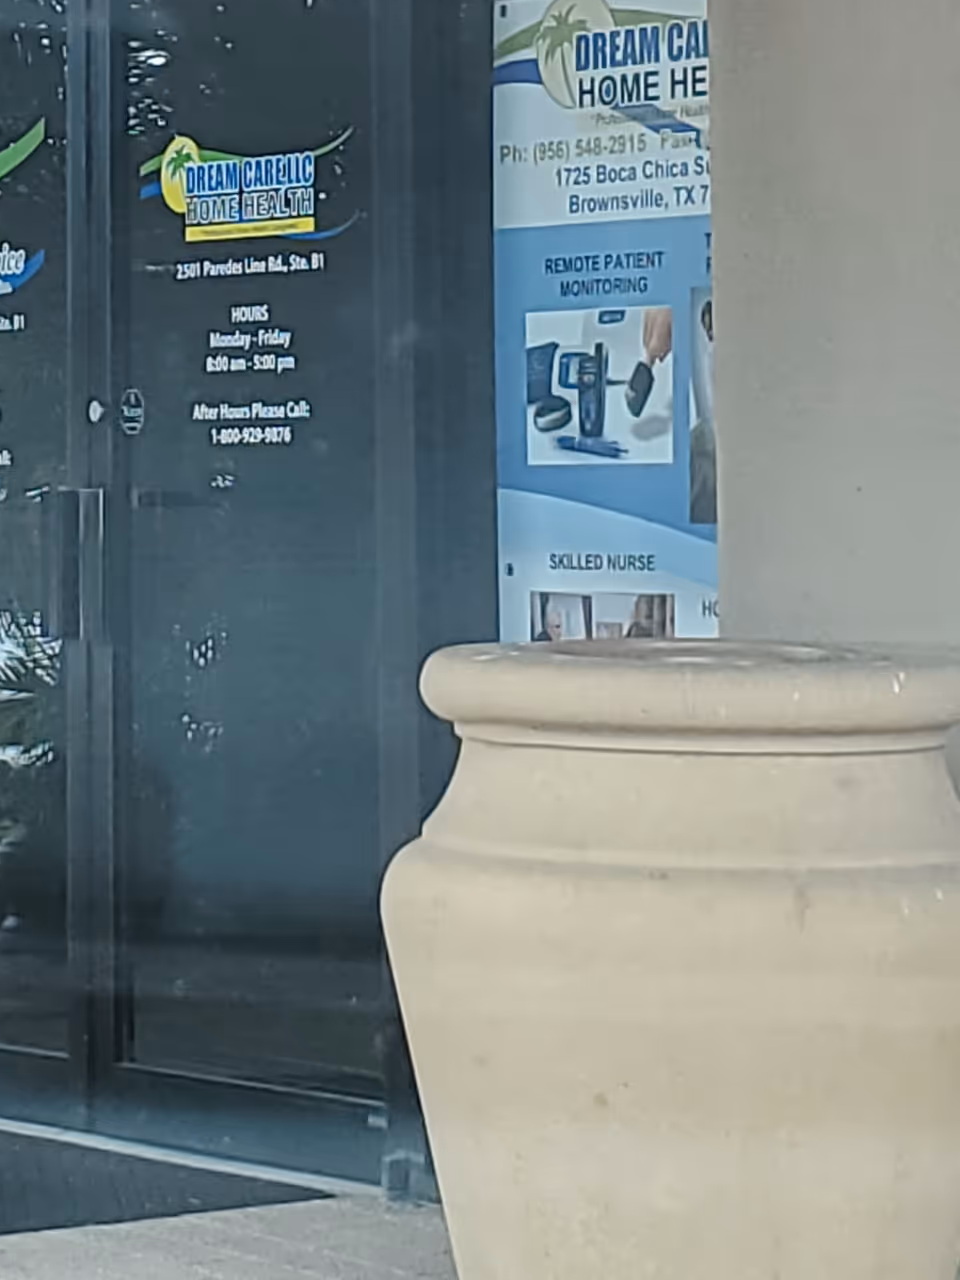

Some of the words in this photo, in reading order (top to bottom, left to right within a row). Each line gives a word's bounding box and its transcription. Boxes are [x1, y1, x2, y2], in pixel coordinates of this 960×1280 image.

[575, 25, 660, 72] DREAM
[578, 71, 660, 108] HOME
[499, 144, 528, 164] Ph:
[533, 139, 570, 166] (956)
[575, 133, 647, 157] 548-2915
[186, 161, 239, 194] DREAM
[556, 165, 591, 187] 1725
[596, 164, 637, 184] Boca
[642, 160, 688, 179] Chica
[186, 196, 239, 224] HOME
[242, 187, 314, 219] HEALTH
[569, 188, 669, 214] Brownsville,
[673, 185, 695, 206] TX
[176, 263, 201, 280] 2501
[203, 258, 243, 277] Paredes
[244, 257, 266, 274] Line
[545, 255, 600, 275] REMOTE
[604, 251, 665, 270] PATIENT
[560, 276, 648, 297] MONITORING
[231, 304, 269, 323] HOURS
[209, 330, 251, 350] Monday
[258, 328, 291, 349] Friday
[253, 354, 276, 370] 5:00
[277, 356, 295, 374] pm
[192, 404, 218, 420] After
[220, 403, 250, 420] Hours
[251, 402, 285, 420] Please
[549, 553, 603, 570] SKILLED
[607, 554, 655, 571] NURSE
